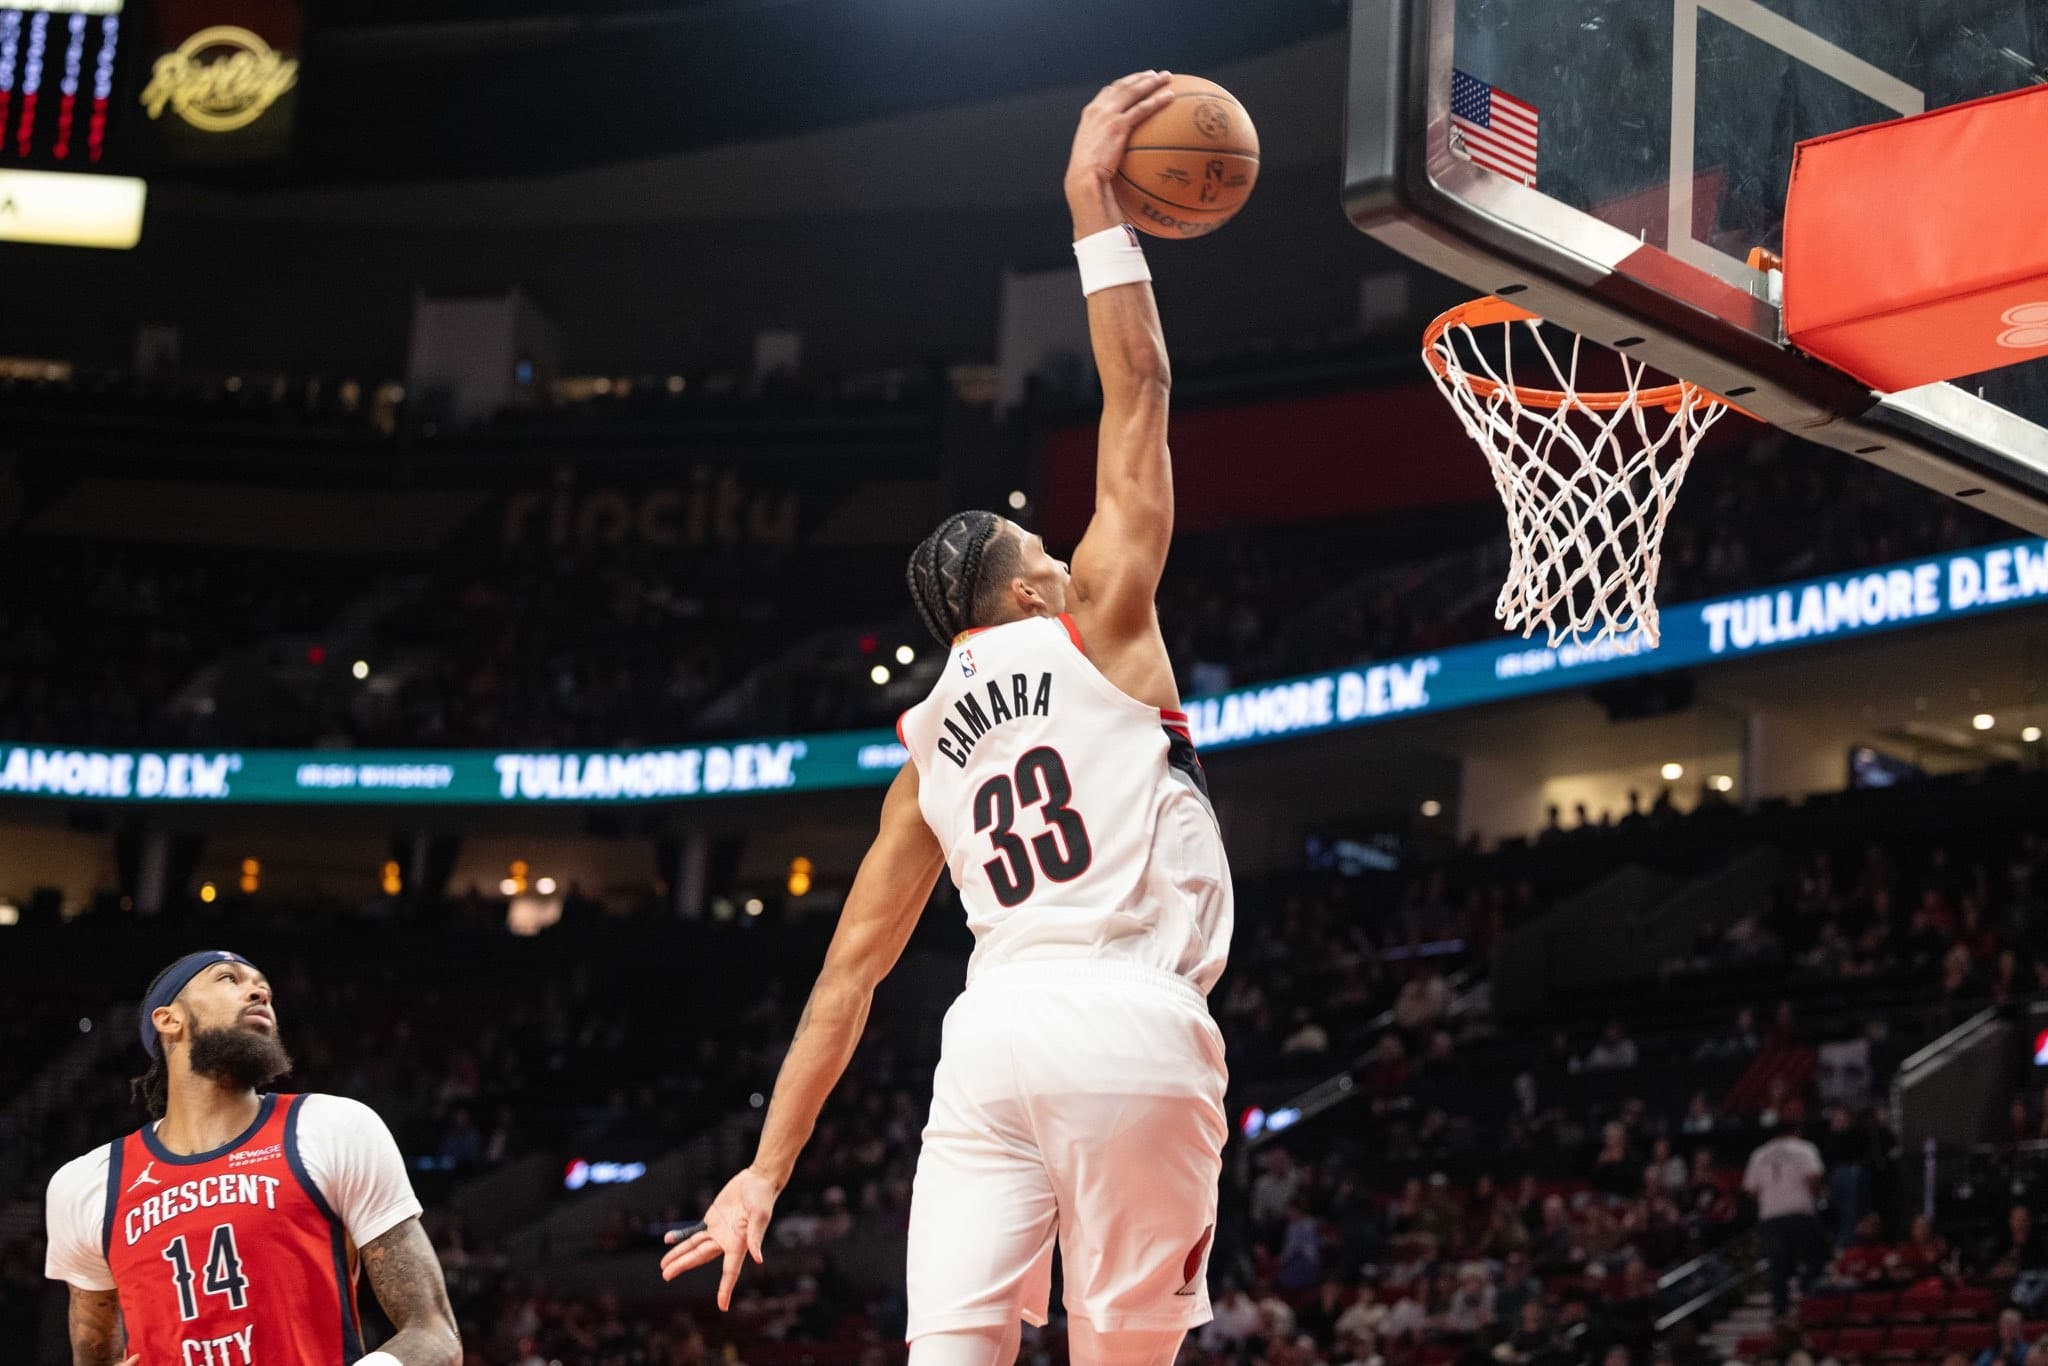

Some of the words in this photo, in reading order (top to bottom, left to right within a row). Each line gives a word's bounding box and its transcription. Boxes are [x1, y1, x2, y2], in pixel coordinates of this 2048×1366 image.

[1701, 564, 1940, 653] TULLAMORE
[937, 672, 1053, 769] CAMARA
[0, 748, 134, 797] AMORE
[494, 750, 701, 798] TULLAMORE
[973, 745, 1092, 908] 33
[124, 1173, 280, 1246] CRESCENT
[161, 1222, 249, 1322] 14
[182, 1323, 253, 1366] CITY
